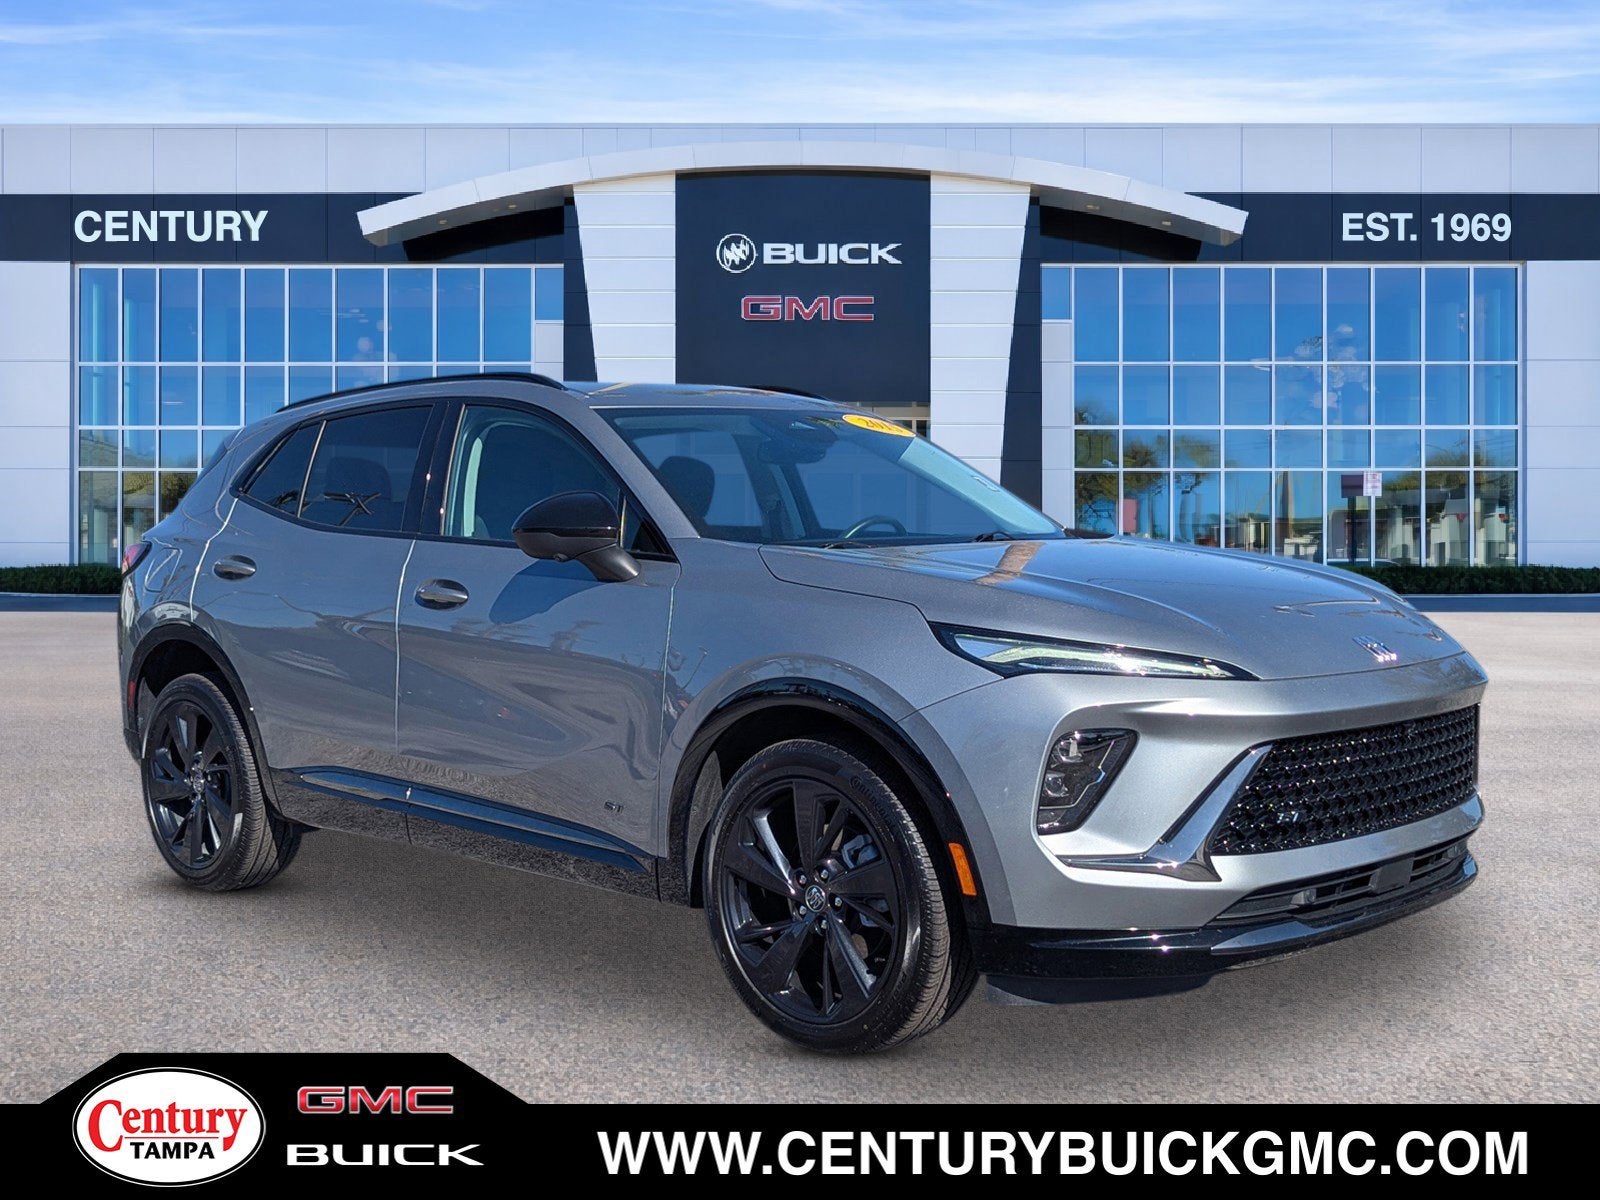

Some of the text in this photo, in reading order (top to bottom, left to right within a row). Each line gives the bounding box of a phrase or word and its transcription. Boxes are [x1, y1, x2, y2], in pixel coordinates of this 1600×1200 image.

[74, 210, 269, 243] CENTURY
[1342, 212, 1512, 242] EST. 1969
[762, 242, 903, 265] BUICK
[740, 295, 875, 321] GMC
